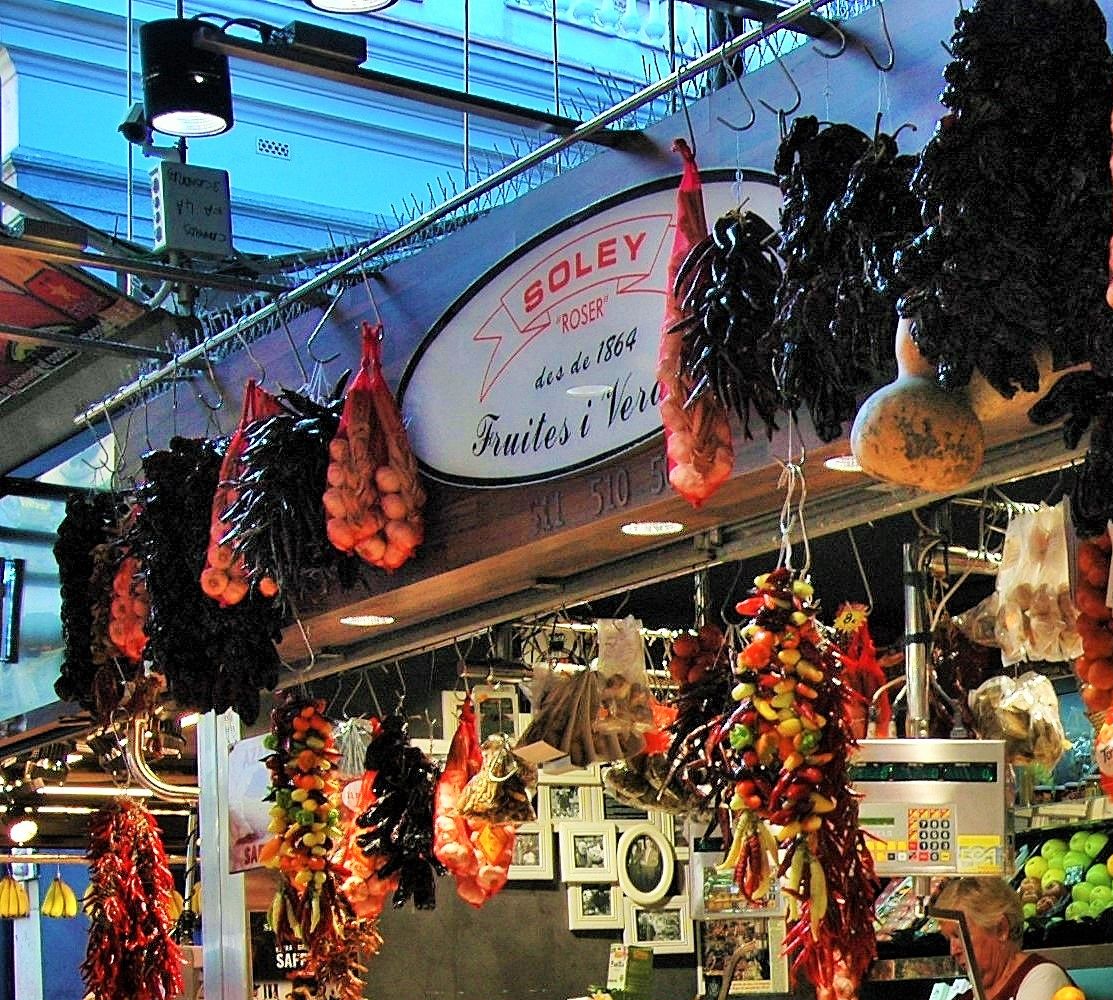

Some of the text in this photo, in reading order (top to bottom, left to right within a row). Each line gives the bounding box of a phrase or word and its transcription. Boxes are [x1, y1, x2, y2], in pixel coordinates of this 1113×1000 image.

[523, 231, 647, 314] SOLEY
[596, 327, 638, 363] 1864
[472, 413, 571, 457] Fruites
[580, 401, 592, 437] i
[589, 470, 632, 516] 510
